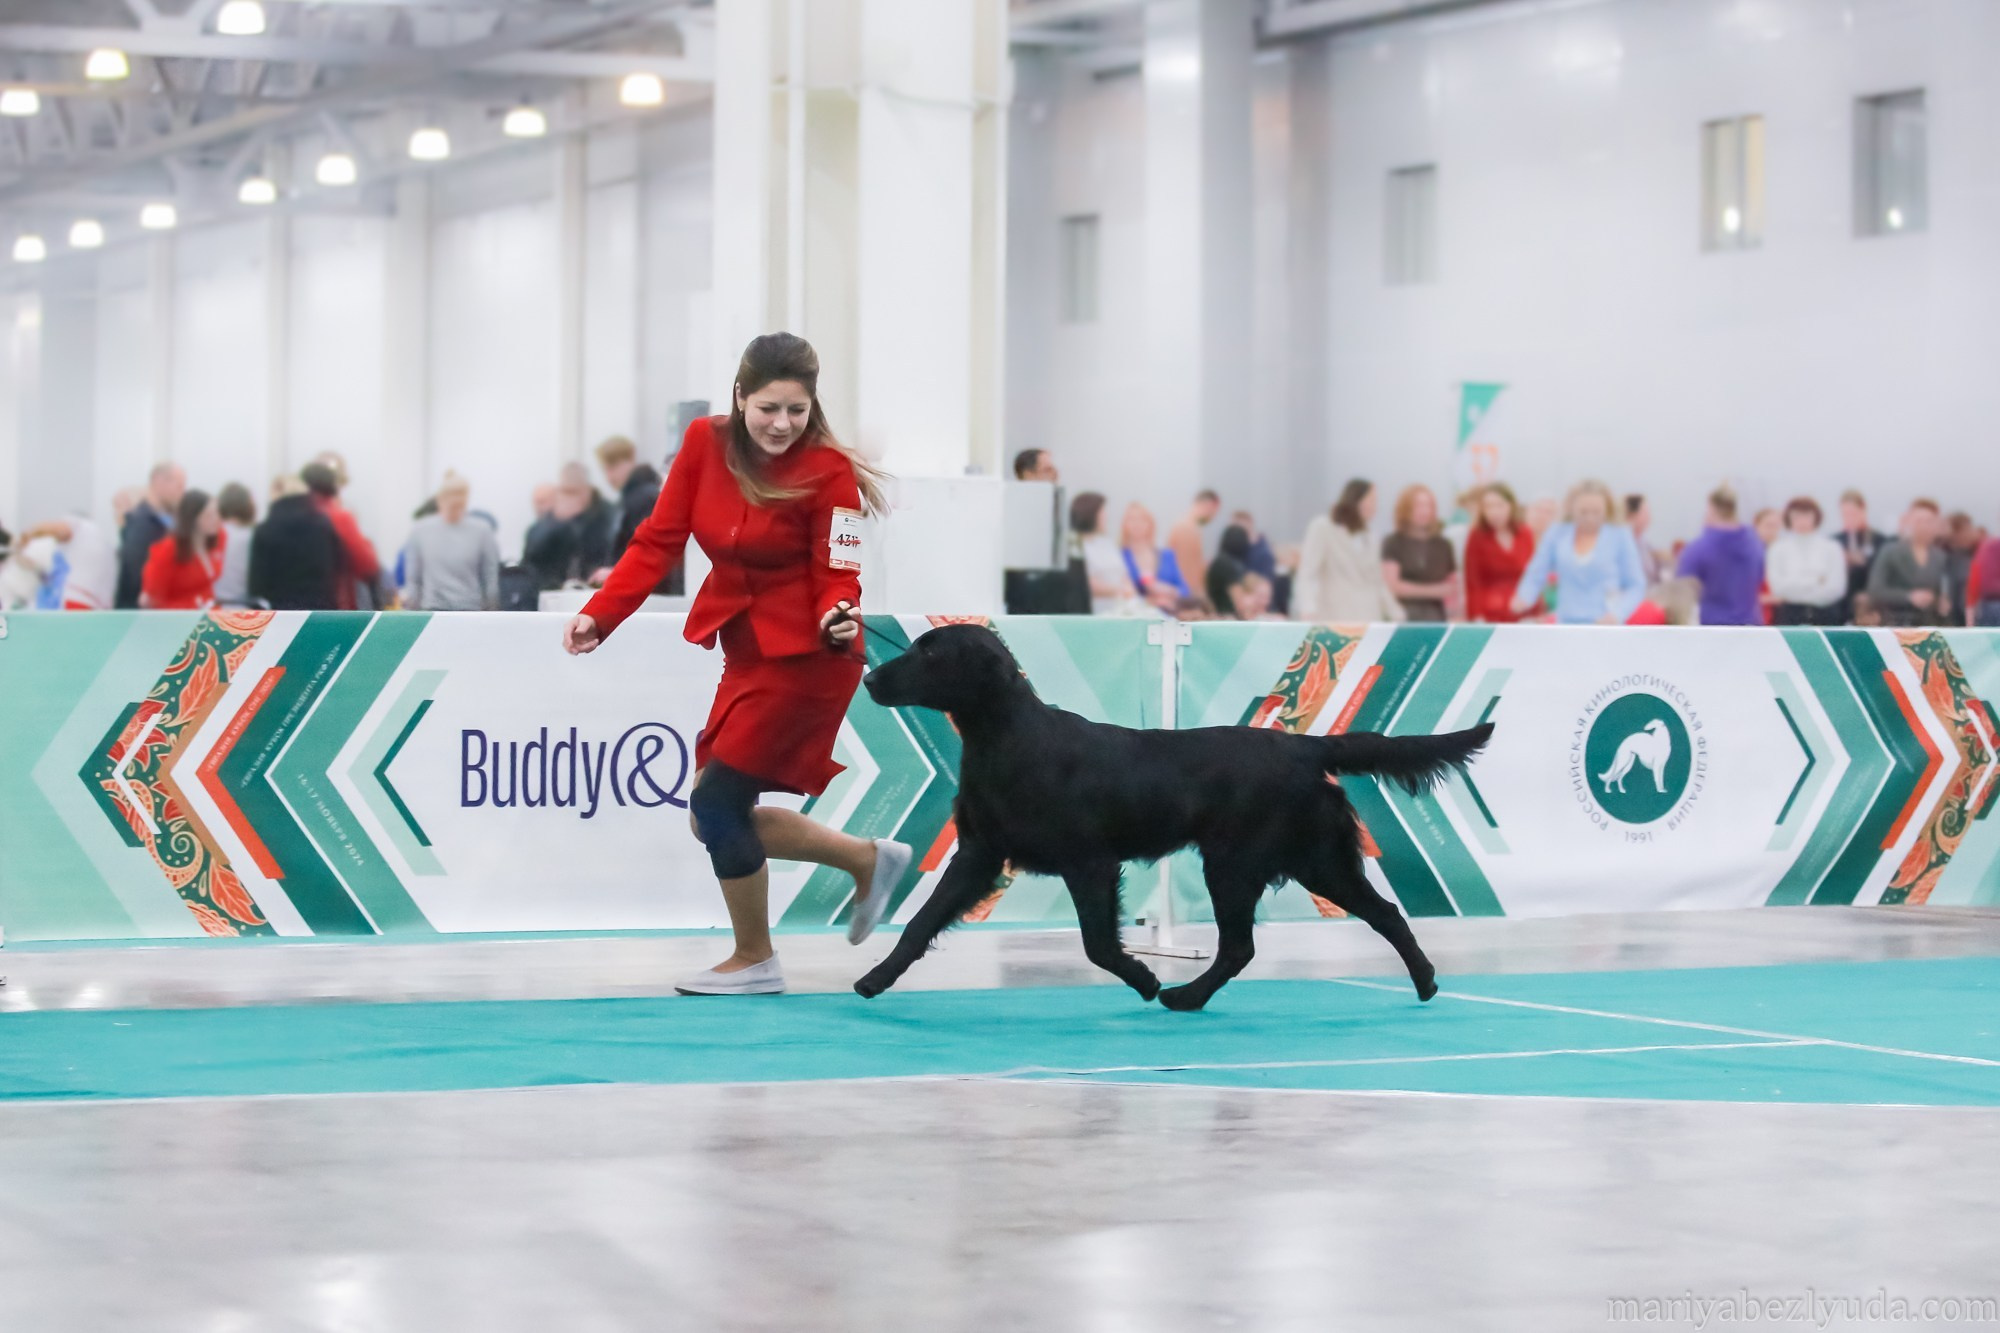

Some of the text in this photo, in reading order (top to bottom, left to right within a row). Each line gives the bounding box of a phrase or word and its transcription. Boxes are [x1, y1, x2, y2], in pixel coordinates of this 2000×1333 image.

[1584, 674, 1703, 731] КИНОЛОГИЧЕСКАЯ
[1568, 717, 1609, 831] РОССИЙСКАЯ
[1667, 736, 1708, 831] ФЕДЕРАЦИЯ
[314, 799, 348, 842] НОЯБРЯ
[343, 841, 365, 867] 2024
[1624, 831, 1653, 843] 1991
